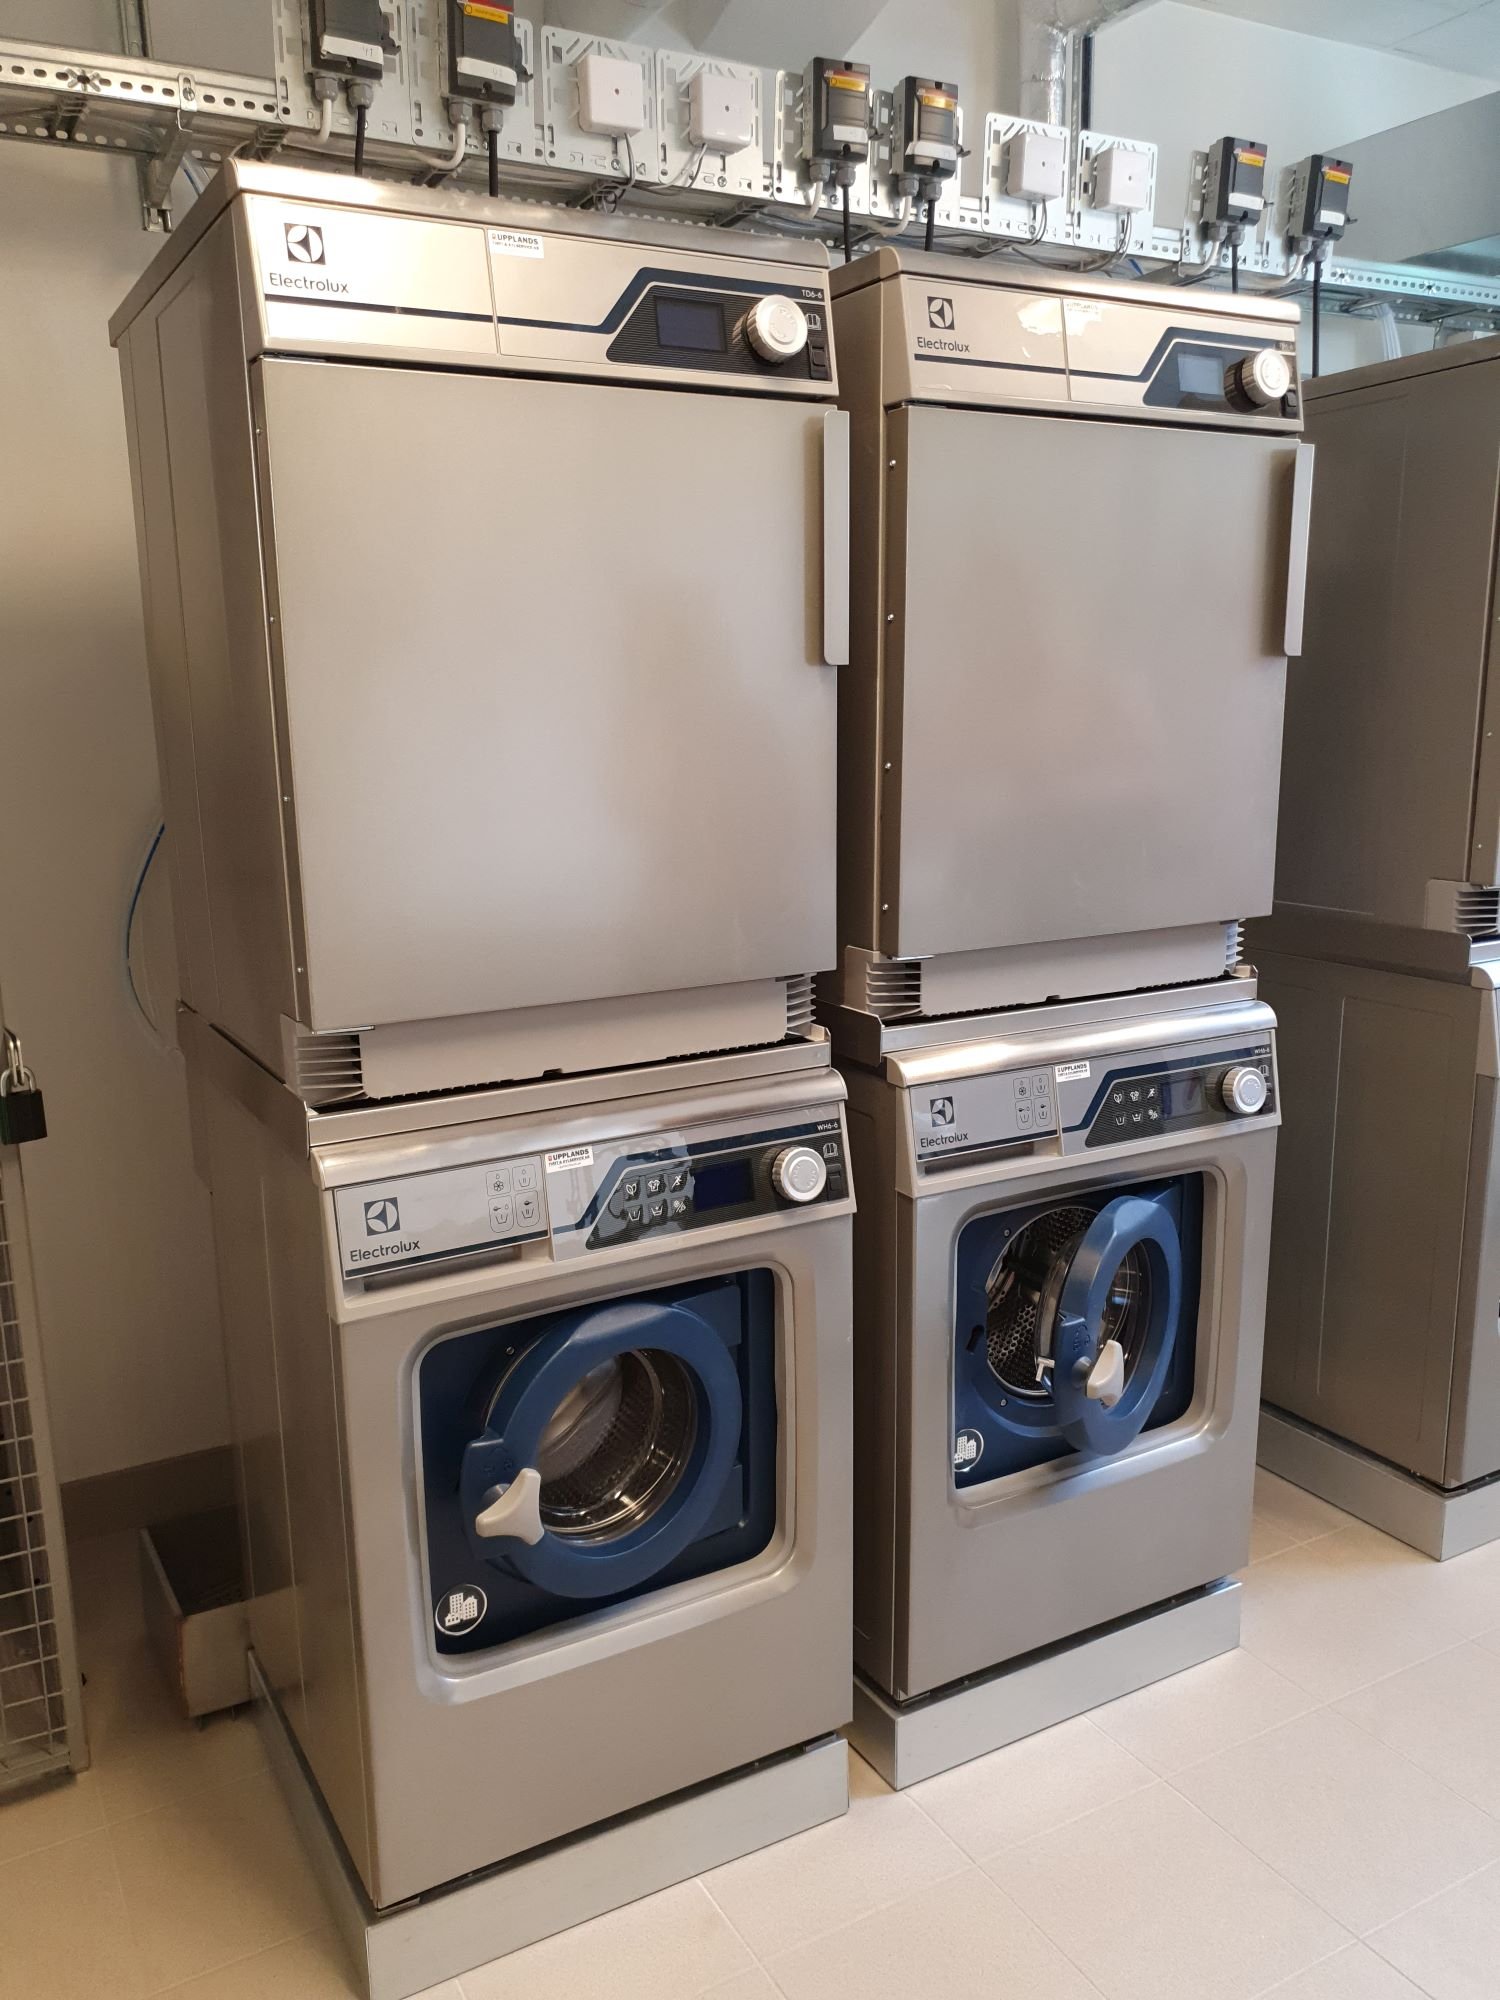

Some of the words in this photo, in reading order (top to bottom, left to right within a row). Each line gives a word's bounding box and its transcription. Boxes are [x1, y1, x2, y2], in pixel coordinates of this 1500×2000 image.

[497, 233, 539, 245] UPPLANDS
[268, 272, 350, 294] Electrolux
[801, 289, 823, 299] TD6-6
[917, 336, 971, 353] Electrolux
[1060, 1063, 1088, 1073] UPPLANDS
[817, 1121, 838, 1131] WH6-6
[920, 1131, 969, 1148] Electrolux
[552, 1148, 590, 1161] UPPLANDS
[349, 1239, 421, 1263] Electrolux
